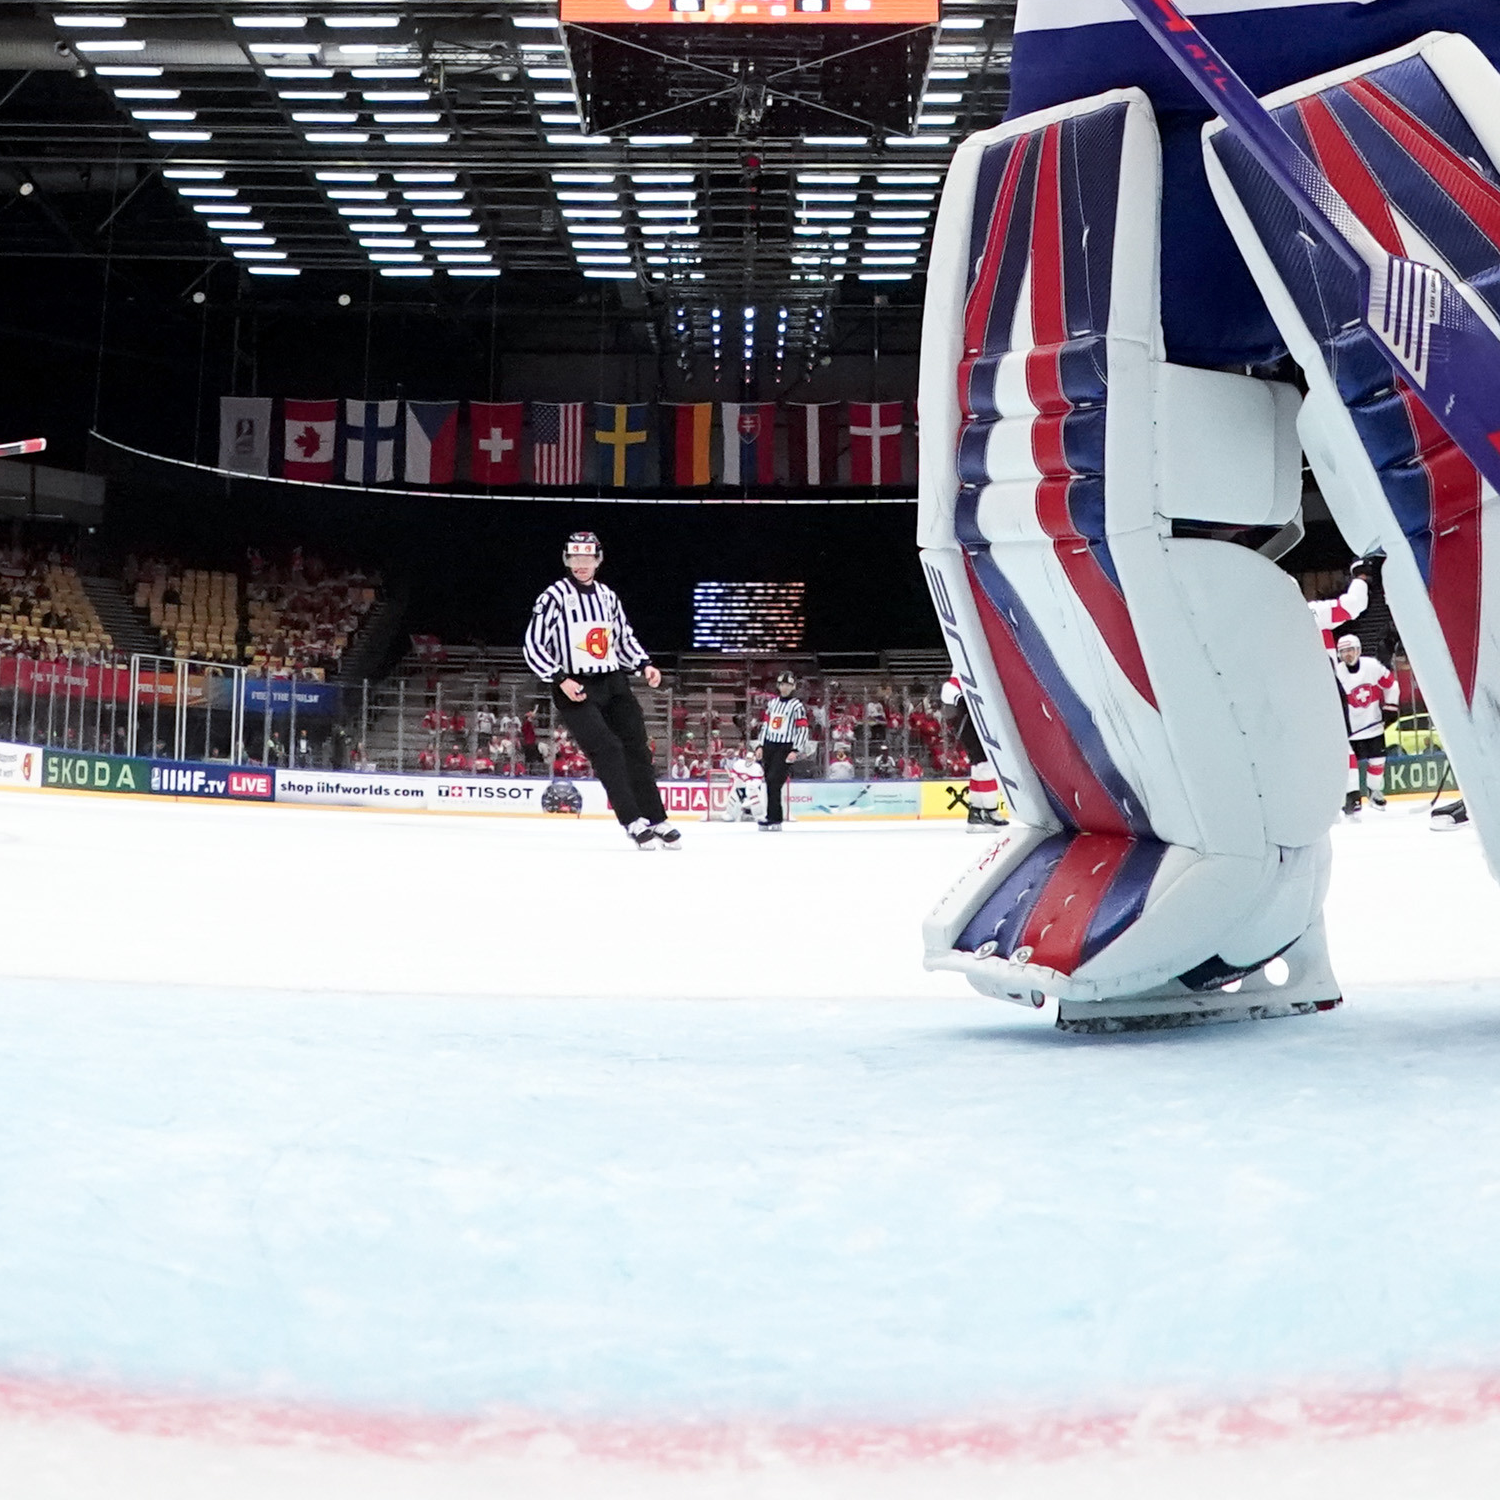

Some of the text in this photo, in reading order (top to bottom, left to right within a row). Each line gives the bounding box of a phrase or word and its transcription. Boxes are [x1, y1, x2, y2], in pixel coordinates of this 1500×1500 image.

[924, 562, 1020, 813] TRUE
[232, 776, 267, 793] LIVE
[280, 780, 424, 799] shop.iihfworlds.com
[466, 786, 534, 800] TISSOT
